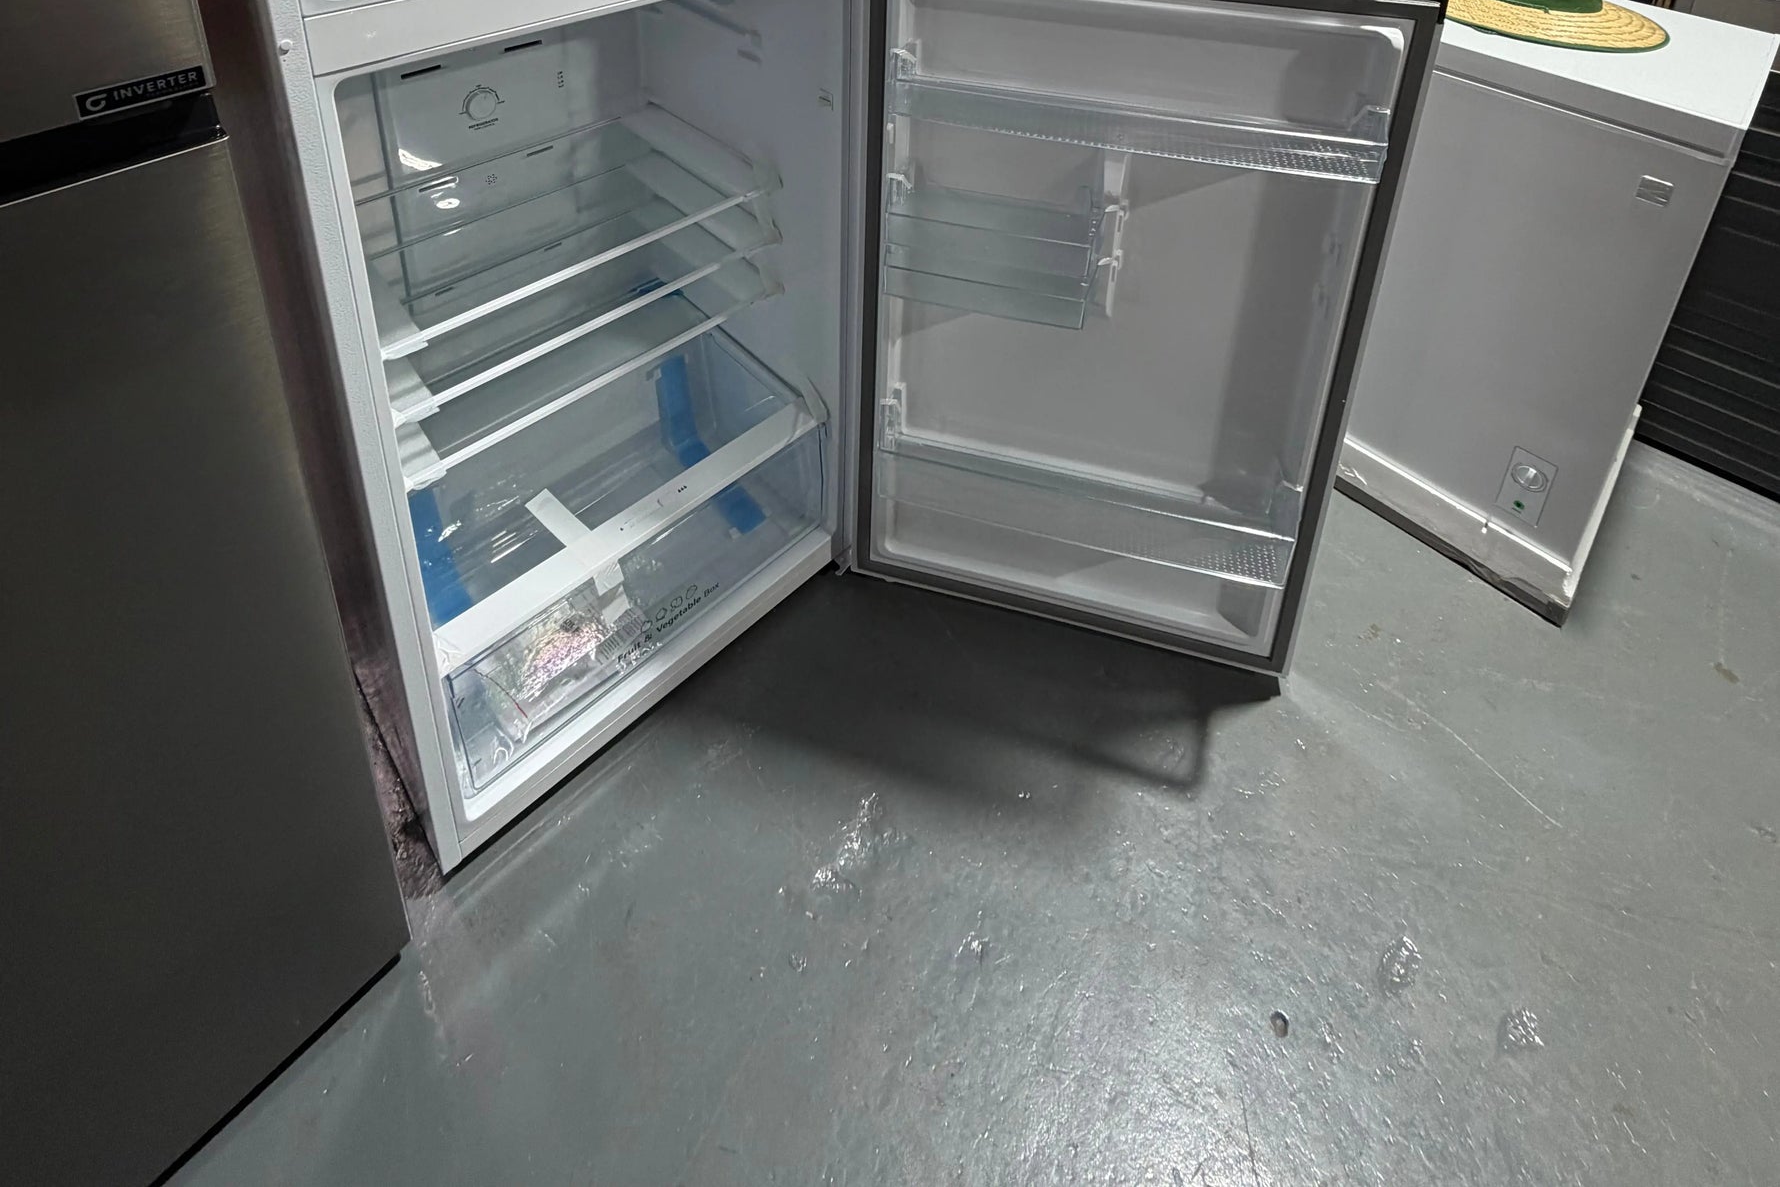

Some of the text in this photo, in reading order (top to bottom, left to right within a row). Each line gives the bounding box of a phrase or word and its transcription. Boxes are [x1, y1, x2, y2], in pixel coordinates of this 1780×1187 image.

[113, 71, 198, 101] INVERTER
[617, 642, 642, 663] Fruit
[656, 596, 702, 632] Vegetable
[703, 582, 720, 598] Box
